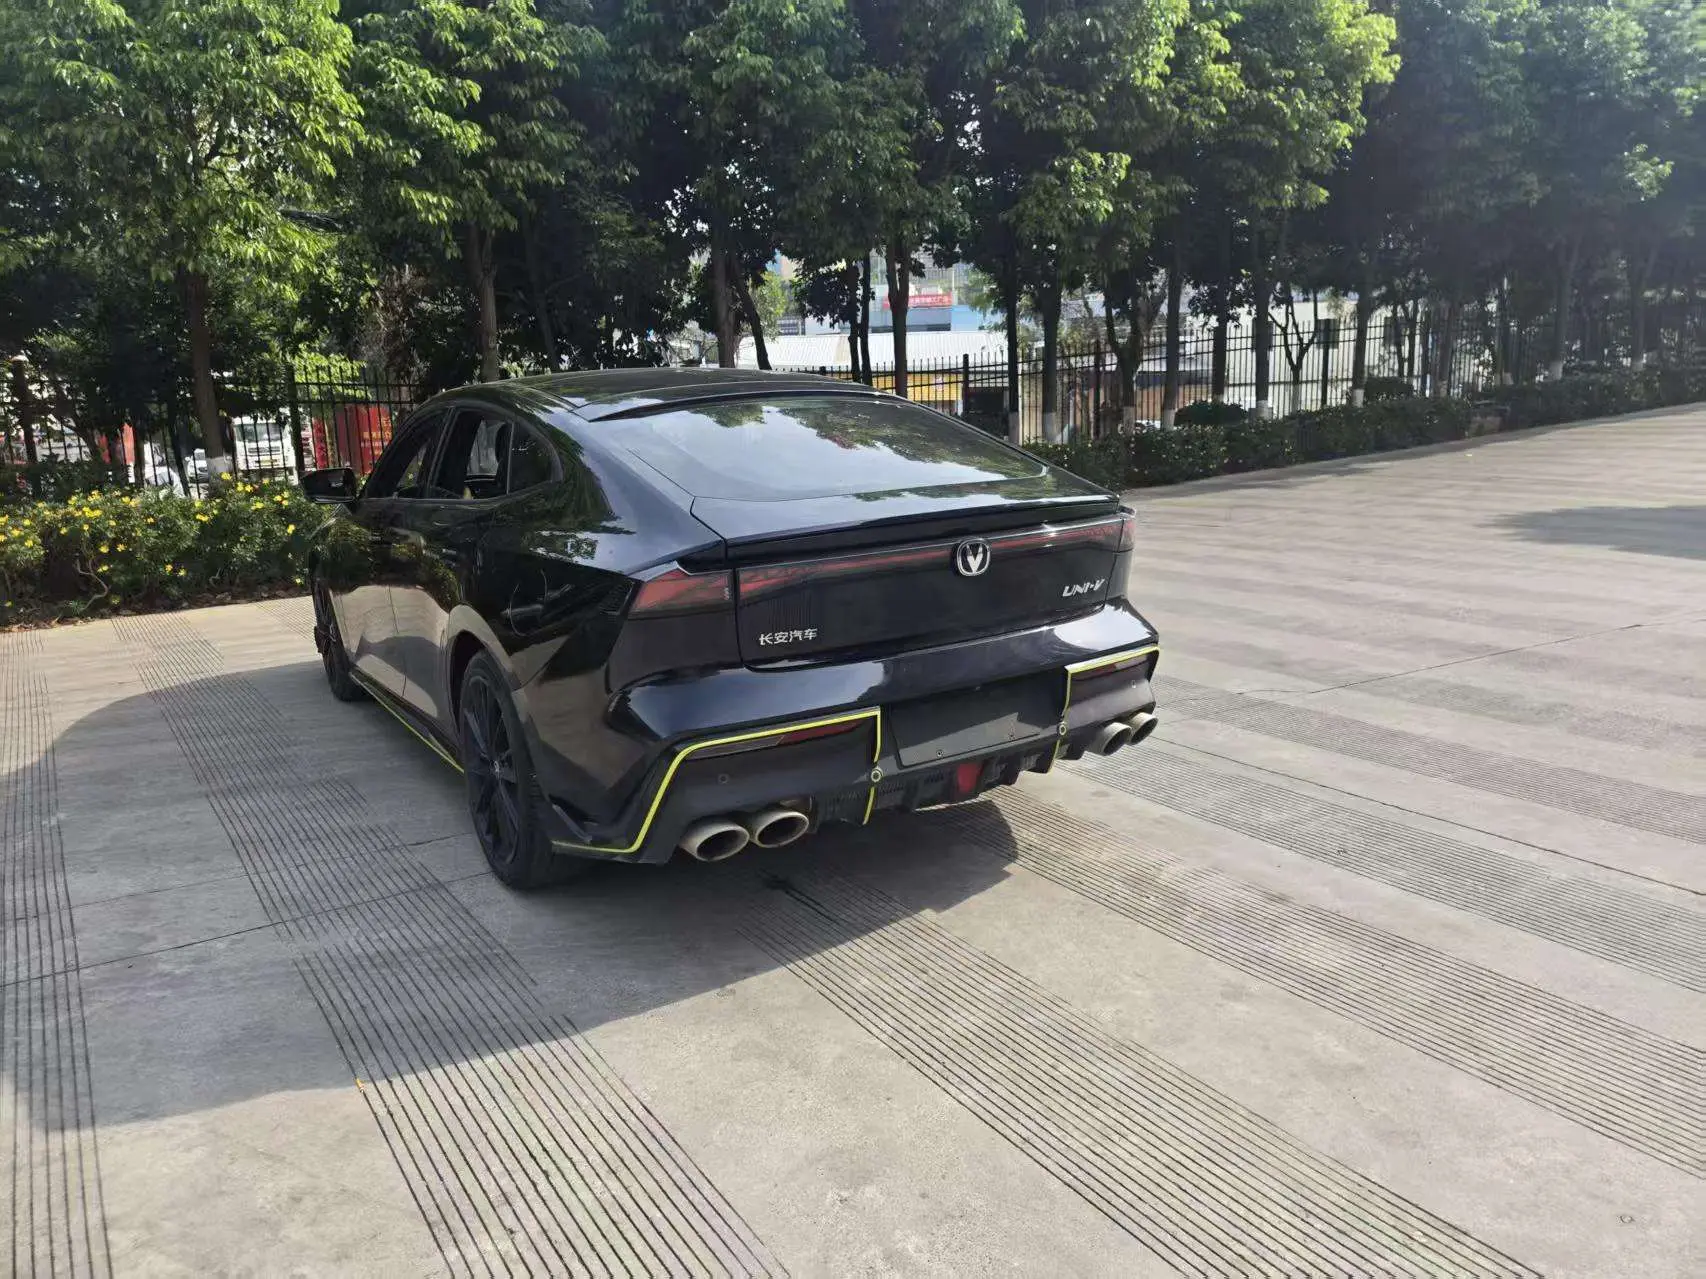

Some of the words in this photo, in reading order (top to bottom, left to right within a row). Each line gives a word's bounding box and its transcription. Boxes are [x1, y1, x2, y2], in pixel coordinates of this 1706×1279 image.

[1062, 579, 1105, 597] UNI-V
[759, 628, 818, 645] 长安汽车
